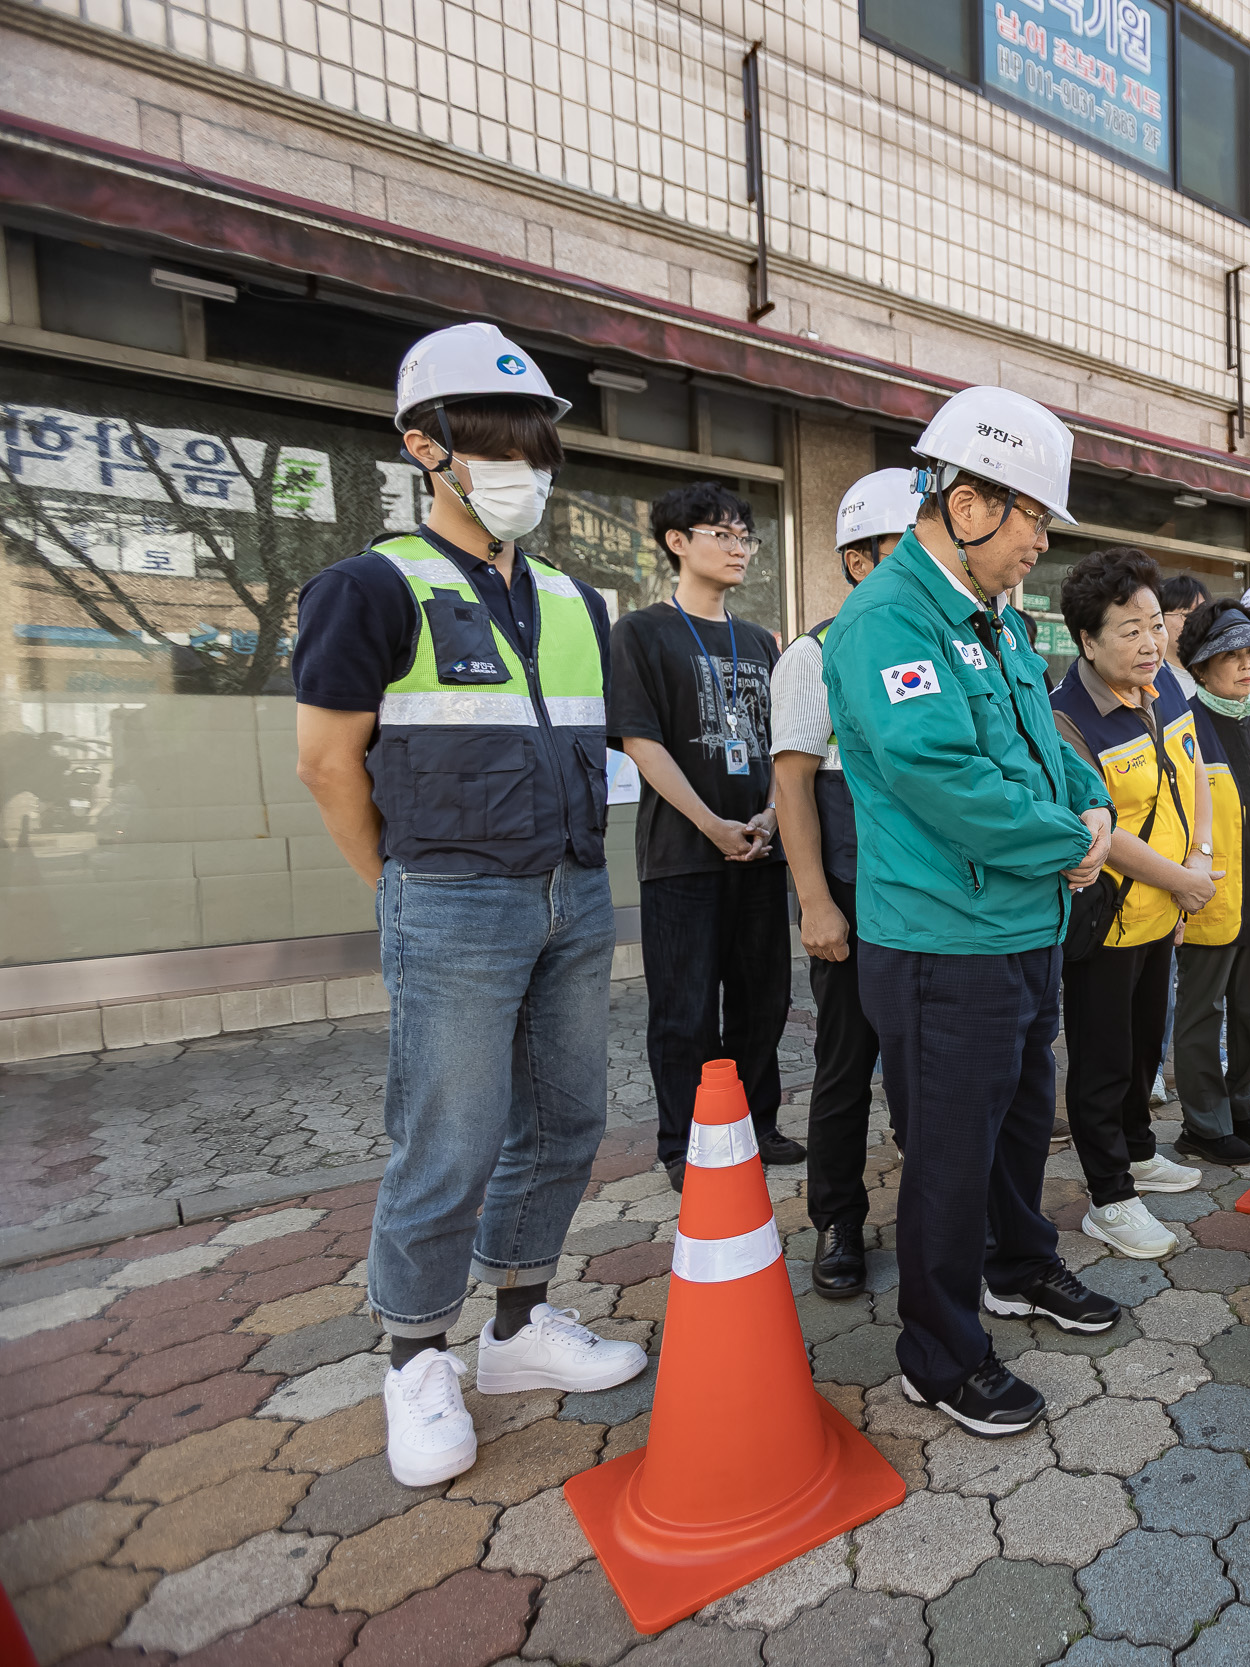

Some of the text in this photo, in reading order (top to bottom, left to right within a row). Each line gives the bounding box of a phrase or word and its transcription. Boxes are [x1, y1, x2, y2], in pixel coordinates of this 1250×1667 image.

[1053, 36, 1118, 98] 초보자
[1122, 74, 1162, 121] 지도
[1142, 122, 1161, 153] 2F
[976, 422, 1023, 448] 광진구
